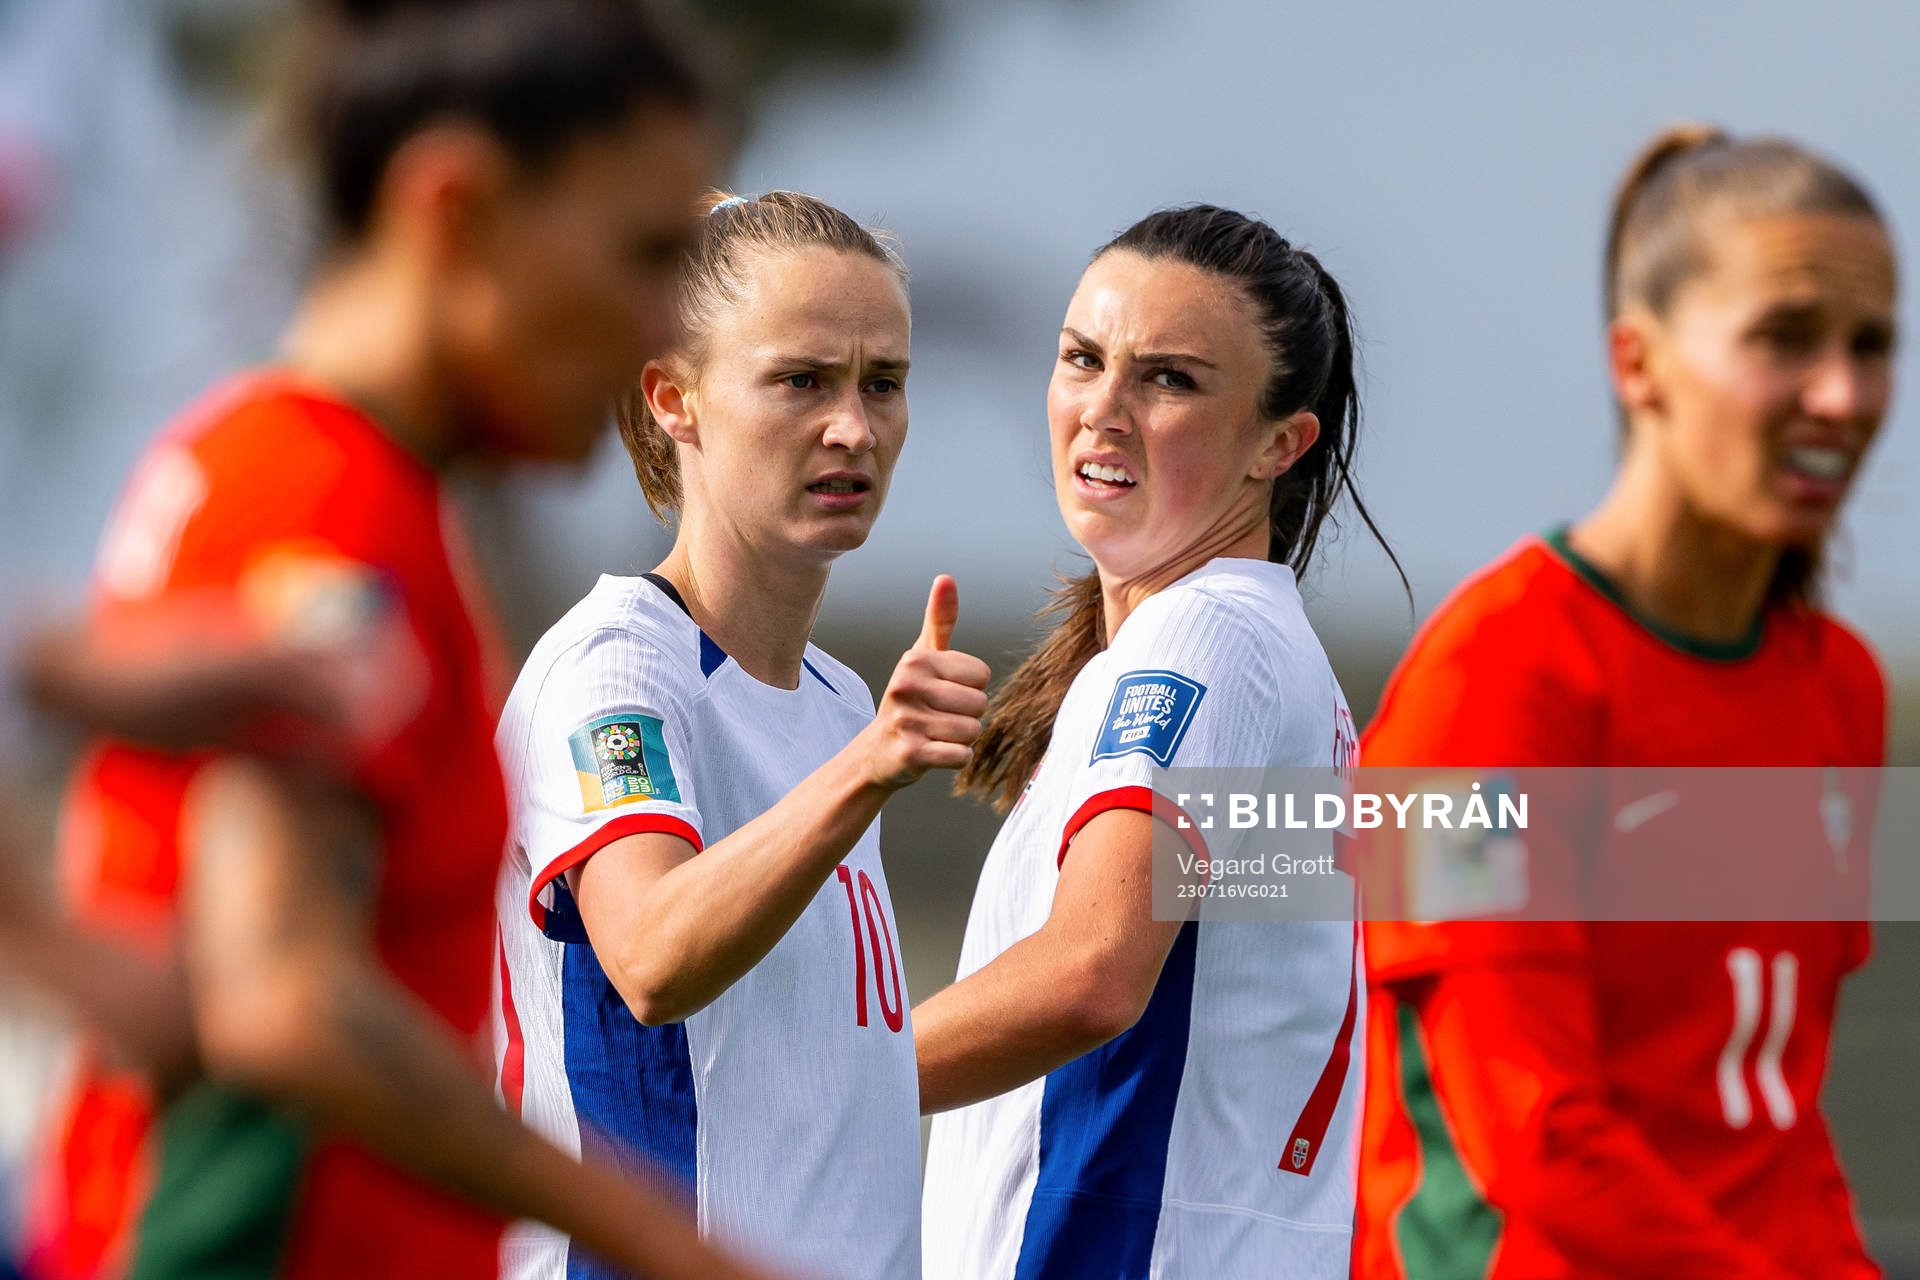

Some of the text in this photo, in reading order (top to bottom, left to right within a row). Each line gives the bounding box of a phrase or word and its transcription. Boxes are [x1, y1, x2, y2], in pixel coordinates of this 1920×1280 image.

[1125, 684, 1176, 700] FOOTBALL
[1120, 695, 1173, 714] UNITES
[1112, 711, 1172, 731] the World
[1124, 730, 1144, 740] FIFA
[627, 776, 649, 785] 20
[629, 784, 651, 793] 23
[836, 864, 903, 1033] 10
[1716, 946, 1799, 1131] 11
